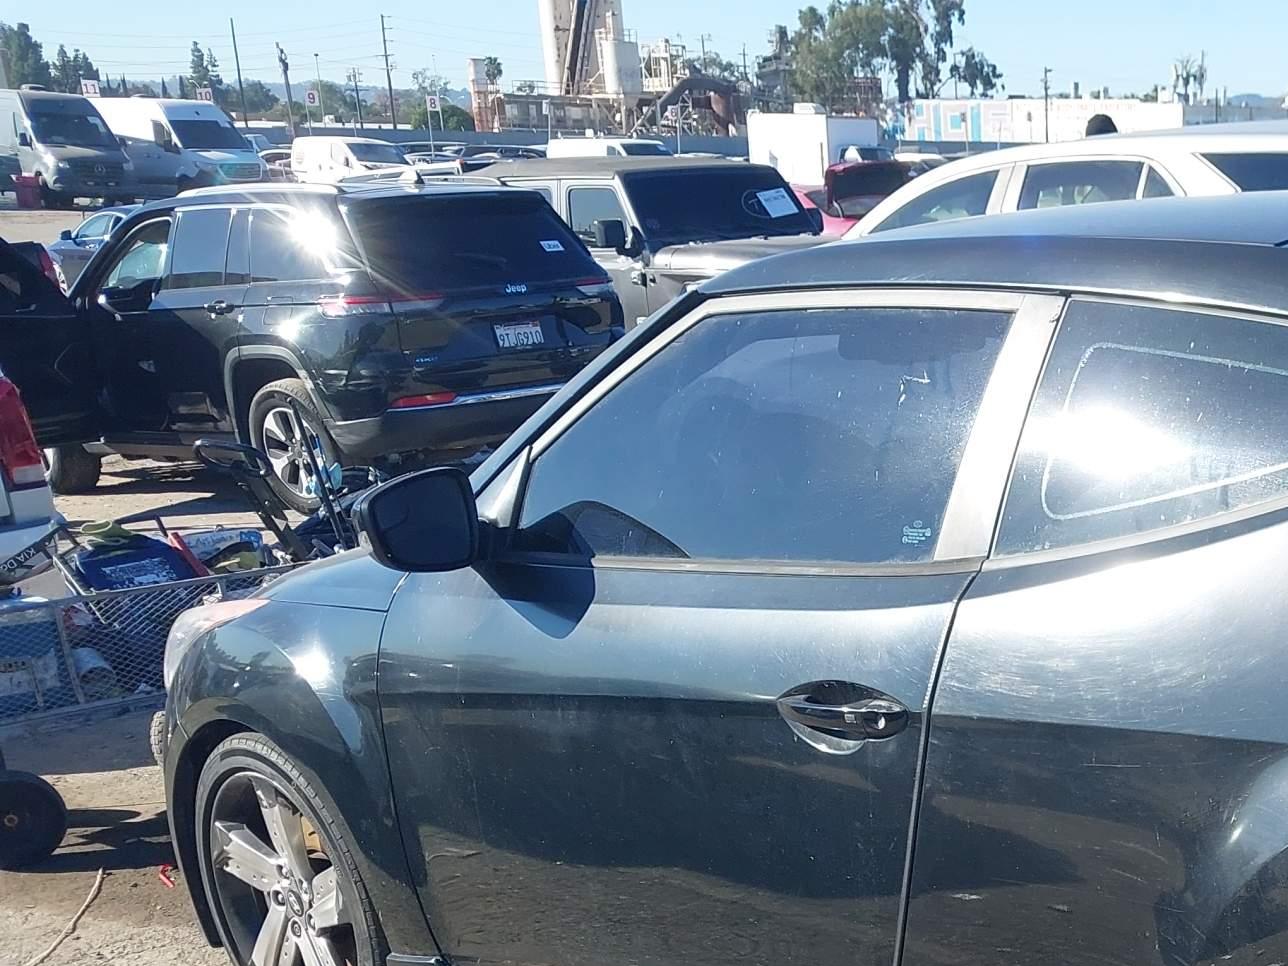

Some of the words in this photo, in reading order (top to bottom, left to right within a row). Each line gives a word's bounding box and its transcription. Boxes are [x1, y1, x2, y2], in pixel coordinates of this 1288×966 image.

[83, 84, 98, 94] 11
[198, 91, 212, 101] 10
[307, 92, 316, 104] 9
[429, 98, 437, 109] 8
[505, 283, 527, 293] Jeep
[499, 330, 544, 347] 9TJG910
[16, 547, 36, 562] KIA
